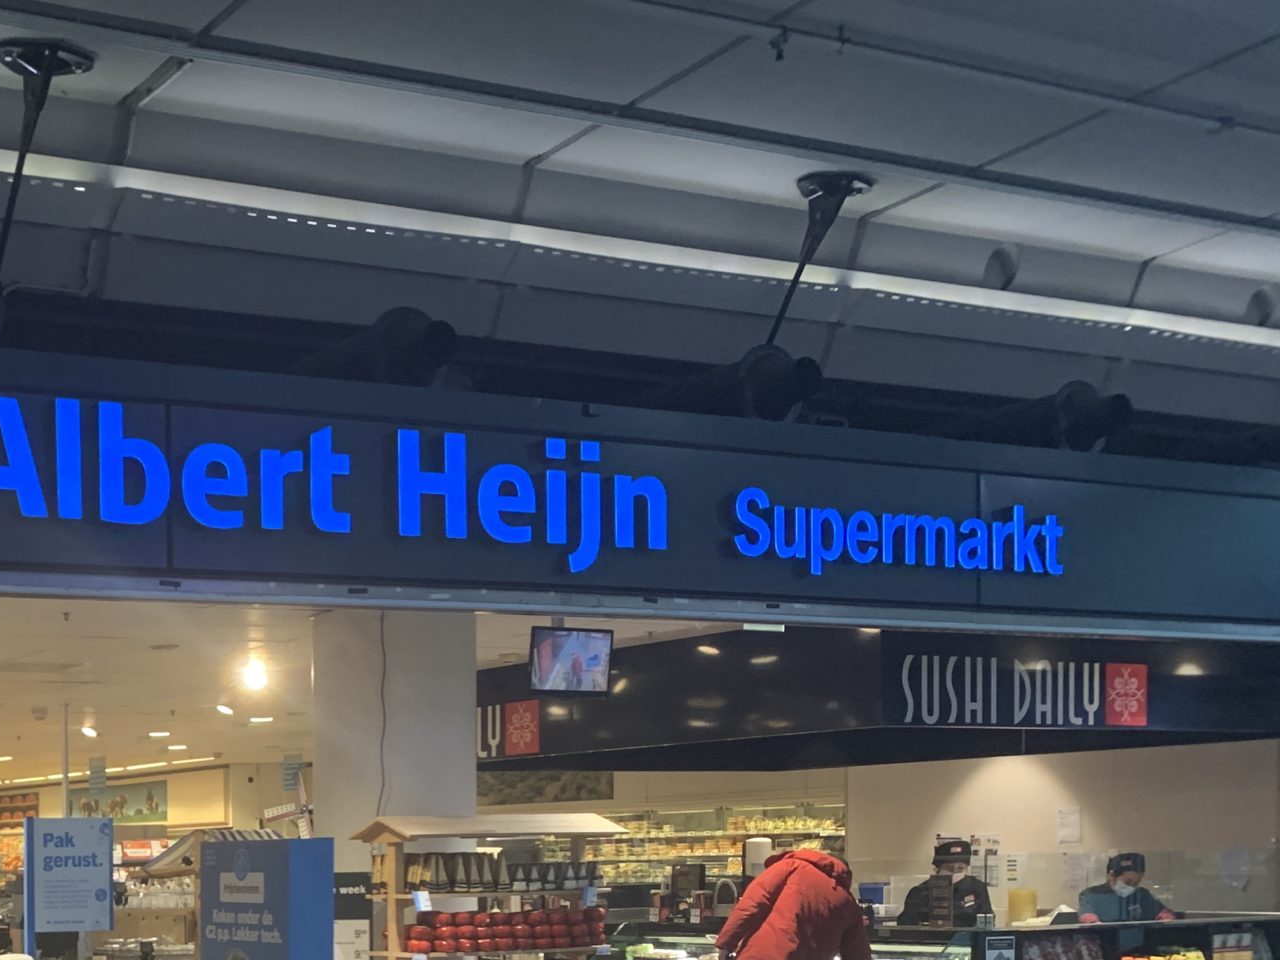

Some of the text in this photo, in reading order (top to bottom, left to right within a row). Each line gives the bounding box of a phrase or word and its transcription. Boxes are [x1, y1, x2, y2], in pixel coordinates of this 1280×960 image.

[397, 428, 668, 573] Heijn
[734, 486, 1064, 576] Supermarkt
[901, 654, 1101, 726] SUSHI DAILY
[43, 831, 76, 848] Pak
[43, 852, 104, 872] gerust.
[339, 884, 366, 894] week
